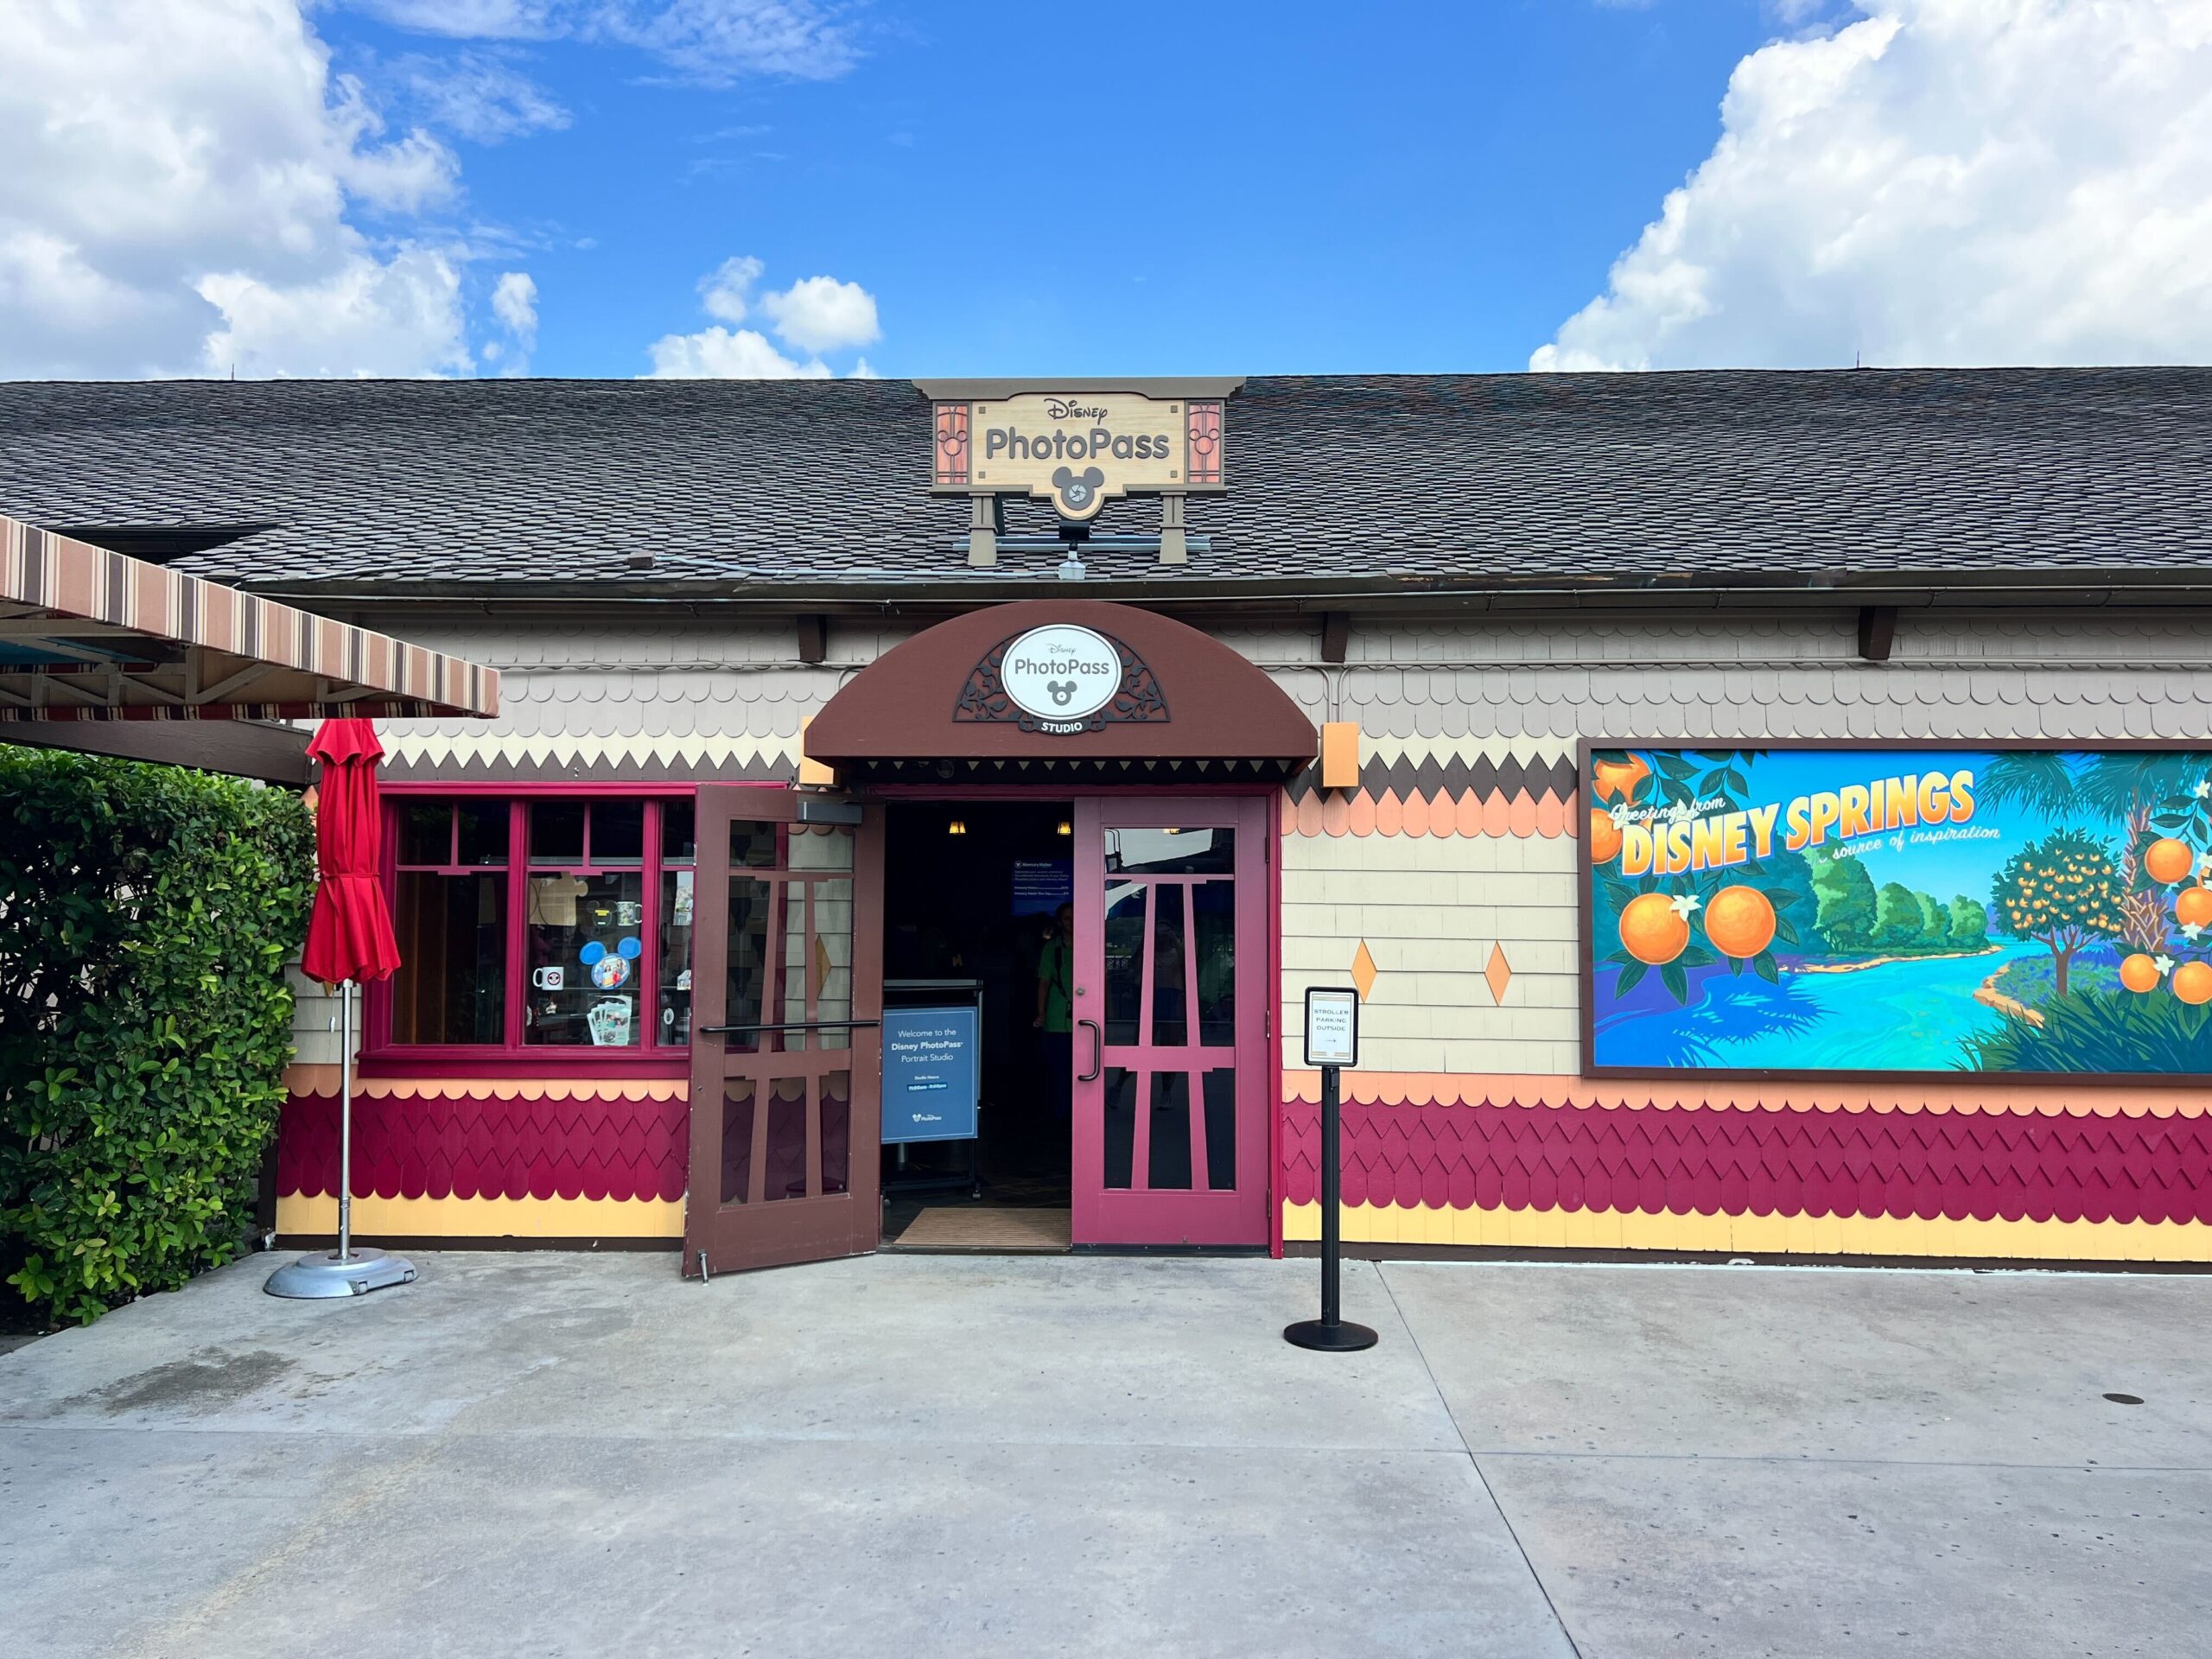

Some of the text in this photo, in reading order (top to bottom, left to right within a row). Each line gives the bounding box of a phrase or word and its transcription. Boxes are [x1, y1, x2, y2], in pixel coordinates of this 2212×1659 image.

[1044, 397, 1108, 425] Disney
[986, 426, 1170, 460] PhotoPass
[1014, 658, 1109, 675] PhotoPass
[1041, 721, 1083, 734] STUDIO
[1690, 797, 1726, 819] from
[1621, 770, 1976, 877] DISNEY SPRINGS
[1833, 825, 2000, 860] source of inspiration
[944, 1027, 957, 1036] the
[891, 1043, 918, 1052] Disney
[930, 1052, 954, 1061] Studio
